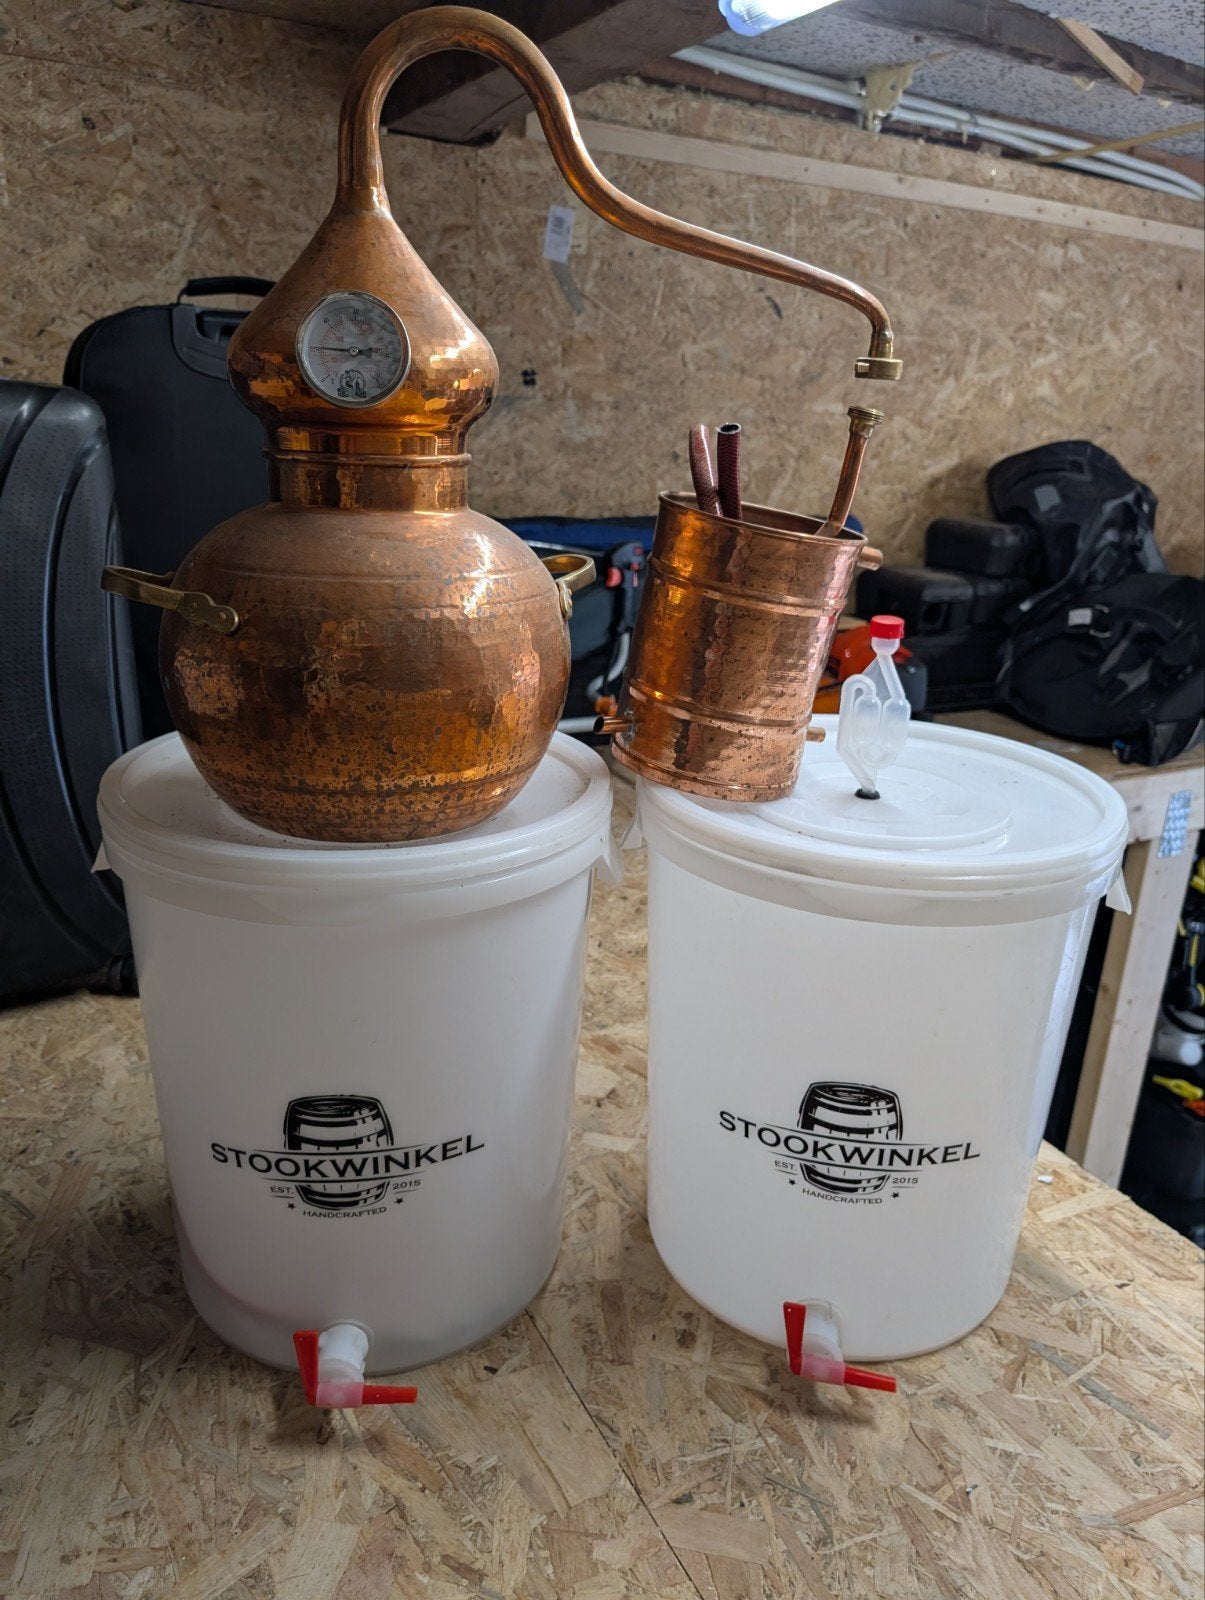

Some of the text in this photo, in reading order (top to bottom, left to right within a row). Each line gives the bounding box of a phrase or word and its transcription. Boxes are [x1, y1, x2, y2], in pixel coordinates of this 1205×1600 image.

[719, 1110, 981, 1167] STOOKWINKEL
[210, 1134, 485, 1178] STOOKWINKEL
[774, 1160, 797, 1171] EST.
[270, 1179, 422, 1195] EST. 2015
[802, 1187, 883, 1205] HANDCRAFTED
[302, 1206, 387, 1218] HANDCRAFTED
